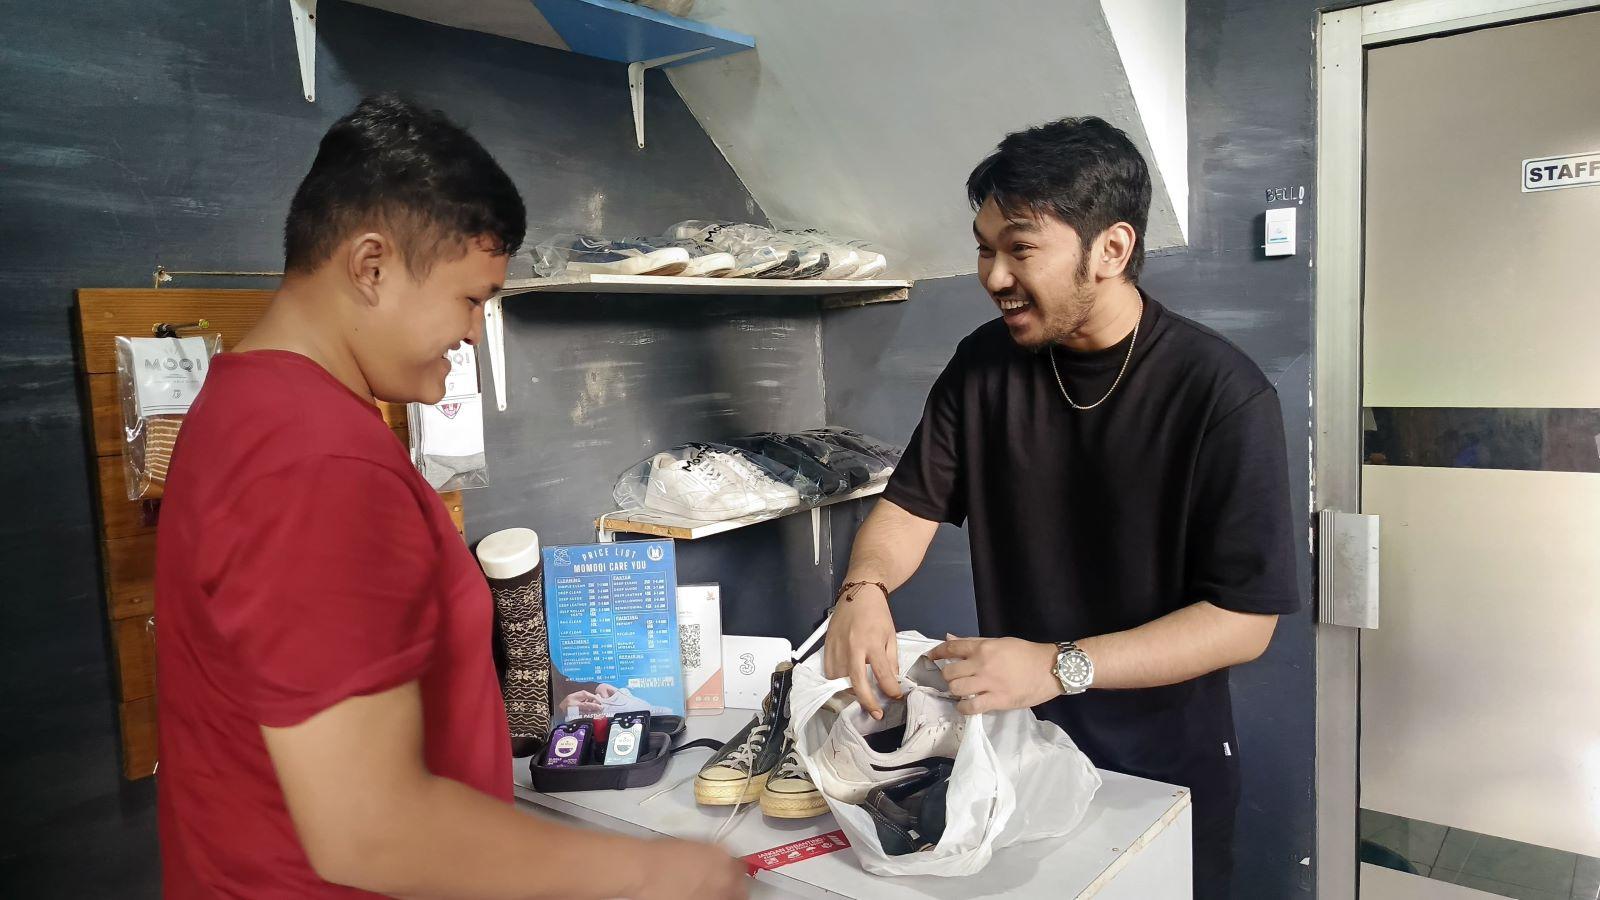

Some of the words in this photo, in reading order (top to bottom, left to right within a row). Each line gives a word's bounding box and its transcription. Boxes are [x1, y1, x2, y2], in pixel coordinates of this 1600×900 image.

[1529, 160, 1600, 183] STAFF
[1265, 185, 1305, 205] BELL!
[144, 358, 202, 373] MOQI
[581, 547, 609, 561] PRICE
[615, 547, 637, 559] LIST
[573, 561, 606, 573] MOMOQI
[609, 561, 628, 572] CARE
[631, 560, 647, 570] YOU
